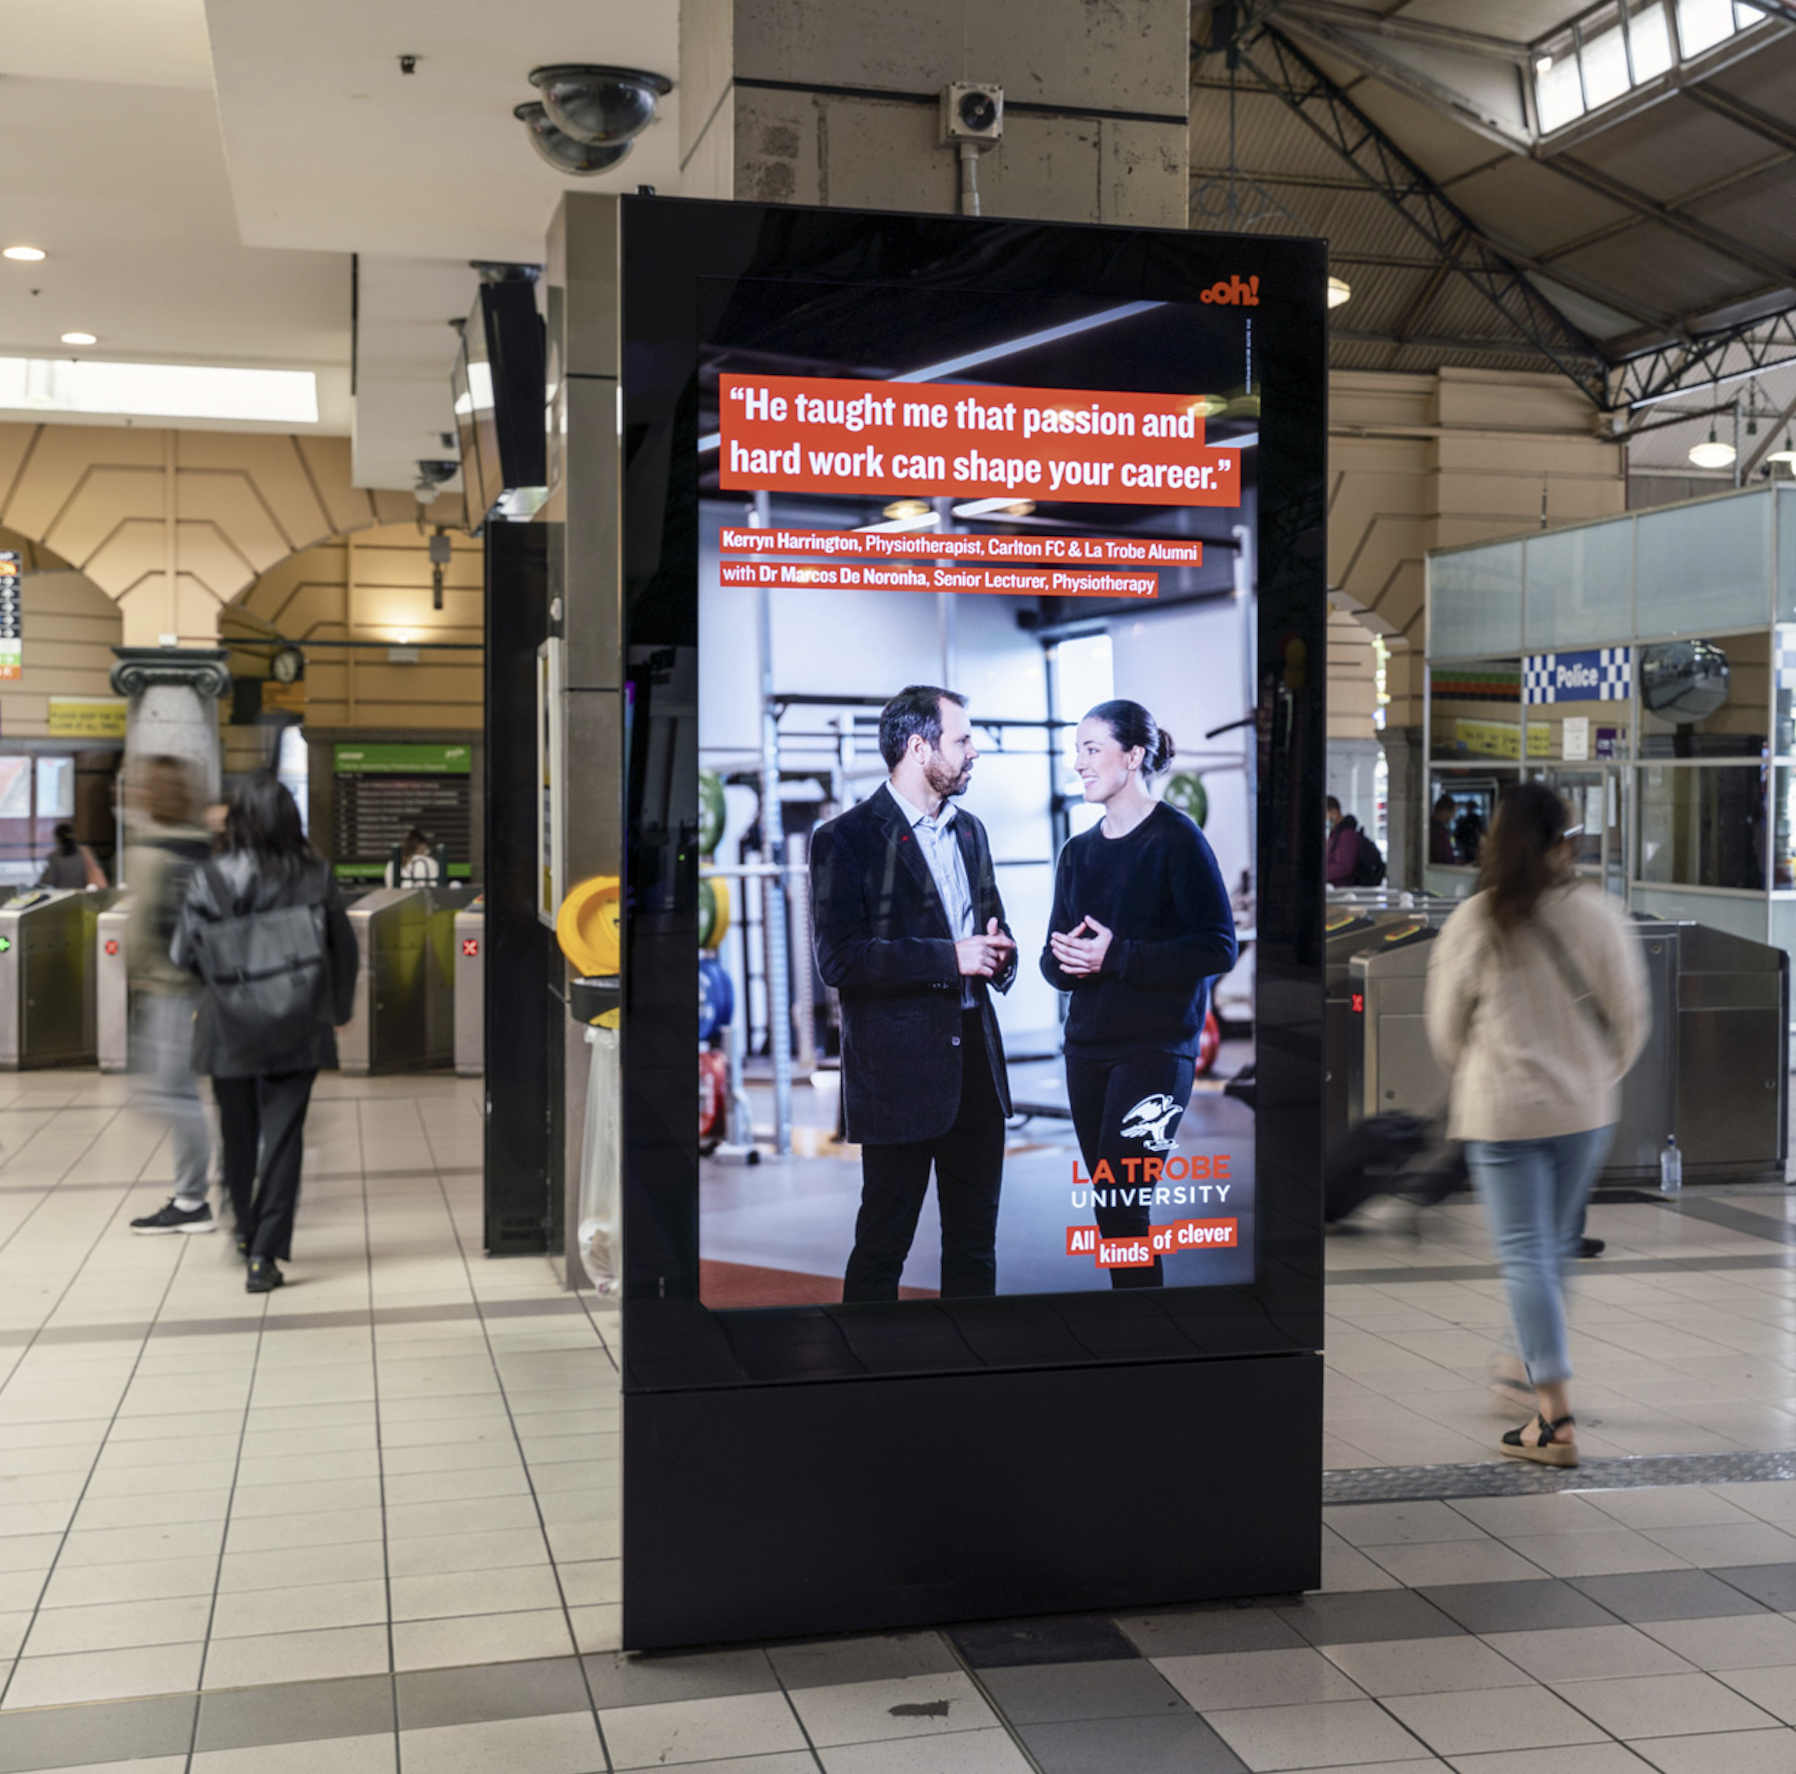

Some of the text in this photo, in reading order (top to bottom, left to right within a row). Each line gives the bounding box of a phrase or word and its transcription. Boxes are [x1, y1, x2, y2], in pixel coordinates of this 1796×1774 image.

[730, 387, 1195, 438] “He taught me that passion and
[730, 440, 1231, 491] hard work can shape your career.”
[722, 530, 1198, 561] Kerryn Harrington, Physiotherapist, Carlton FC & La Trobe Alumni
[722, 564, 1155, 595] with Dr Marcos De Noronha, Senior Lecturer, Physiotherapy
[1556, 663, 1599, 690] Police
[1072, 1155, 1231, 1184] LA TROBE
[1072, 1184, 1231, 1208] UNIVERSITY
[1070, 1223, 1232, 1263] All kinds of clever
